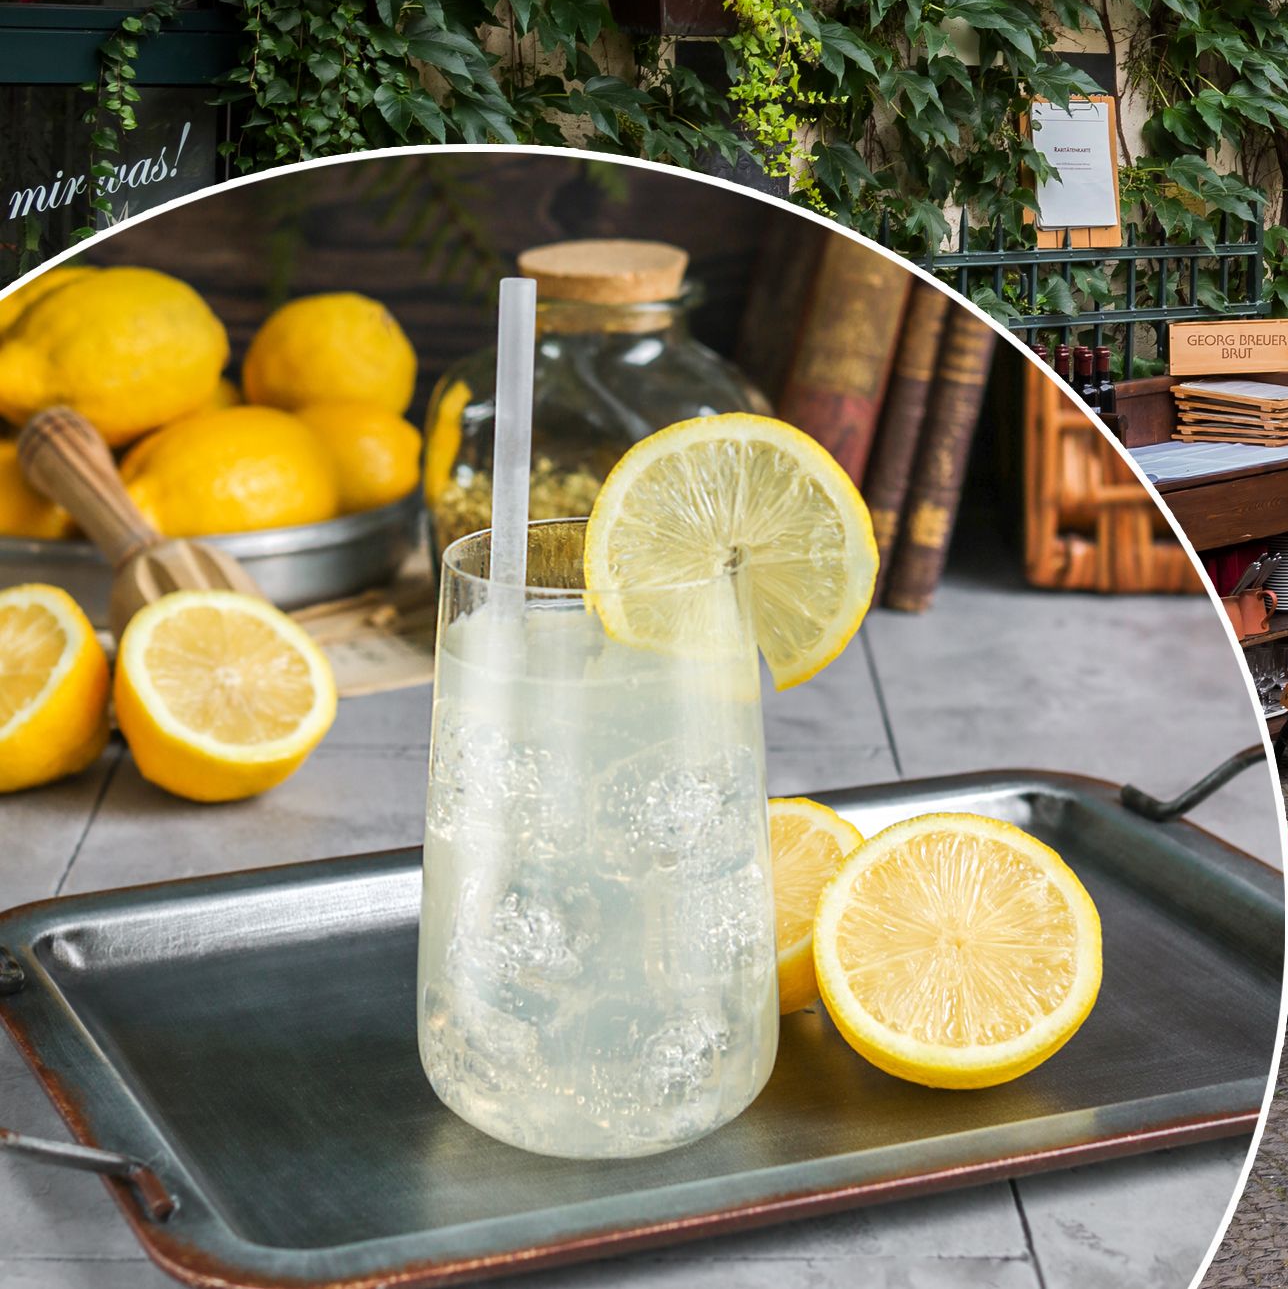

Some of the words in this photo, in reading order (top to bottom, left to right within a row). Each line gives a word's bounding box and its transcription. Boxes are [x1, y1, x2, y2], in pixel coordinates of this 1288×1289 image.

[8, 170, 88, 220] mir
[96, 121, 192, 197] was!
[1187, 334, 1235, 346] GEORG
[1239, 334, 1288, 346] BREUER
[1221, 347, 1253, 359] BRUT
